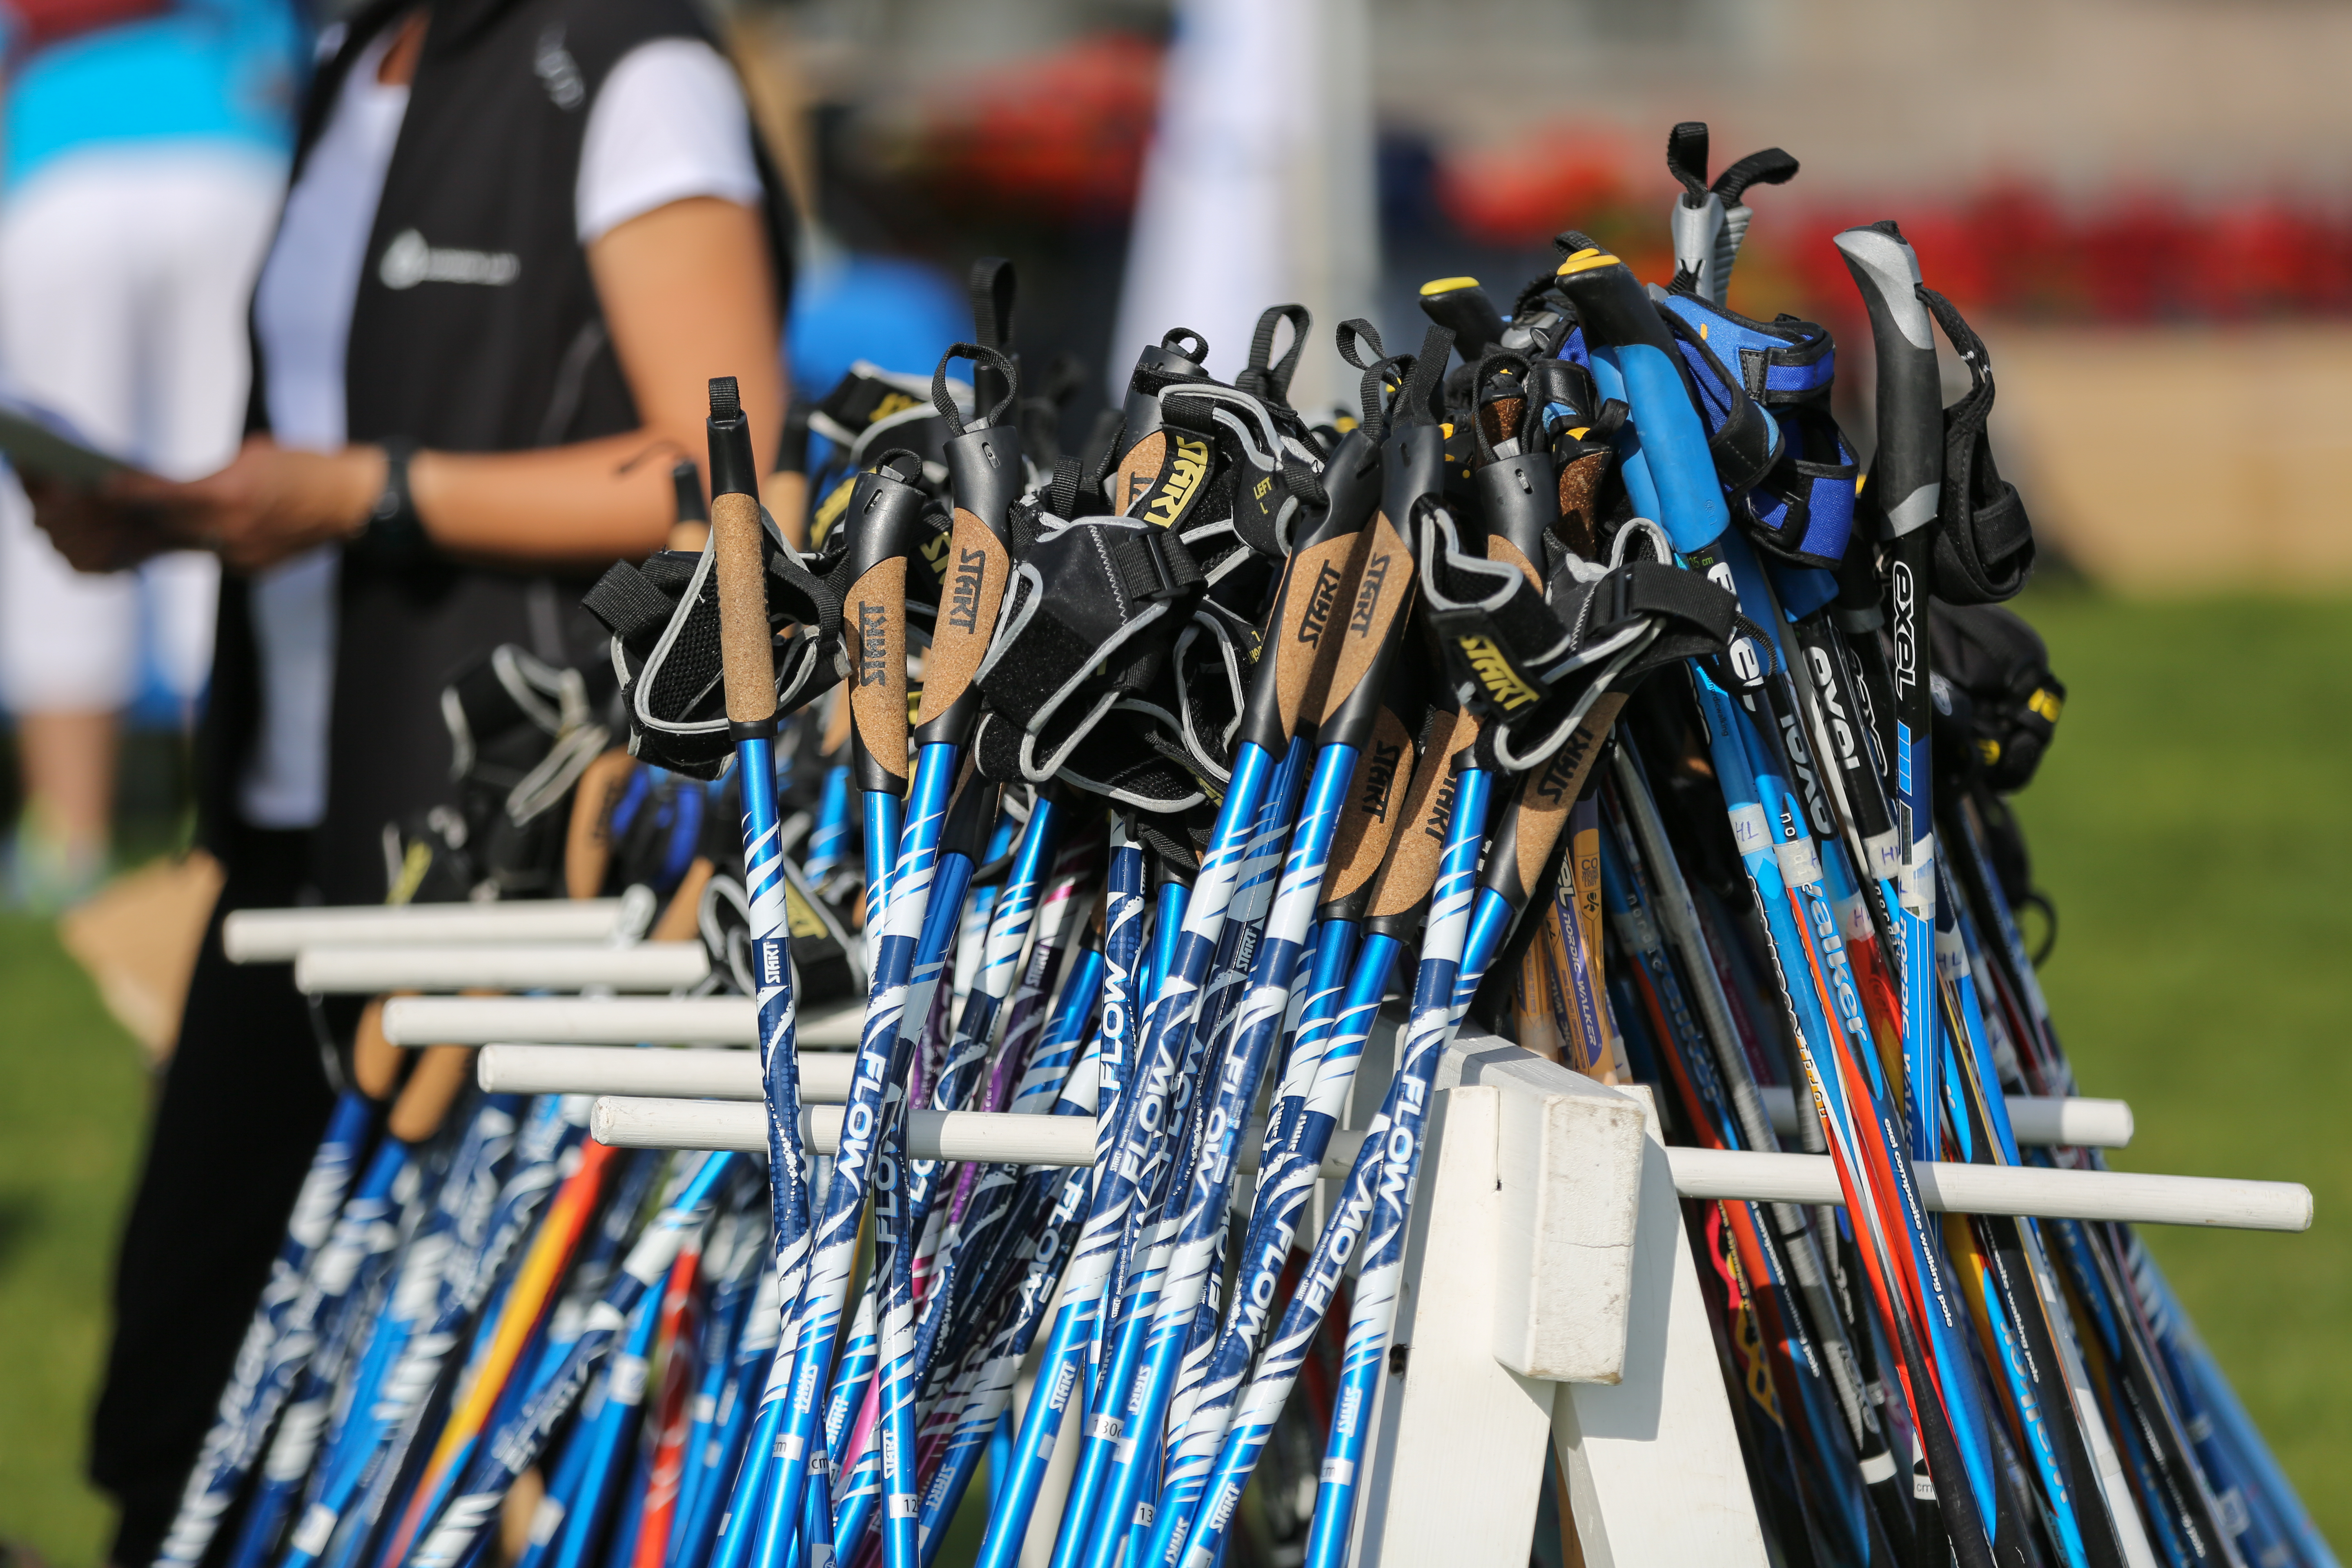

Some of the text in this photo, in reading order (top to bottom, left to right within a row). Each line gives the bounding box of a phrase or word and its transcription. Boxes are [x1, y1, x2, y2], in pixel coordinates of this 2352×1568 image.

[1143, 436, 1208, 529] START
[1254, 477, 1273, 500] LEFT
[949, 548, 986, 635] START
[1298, 559, 1341, 649] START
[1350, 553, 1391, 638] START
[859, 601, 885, 687] START
[1247, 646, 1262, 664] IGHT
[1459, 635, 1540, 711] START
[1362, 740, 1400, 824] START
[1537, 725, 1594, 805] START
[1425, 777, 1457, 849] TART
[1581, 858, 1598, 871] CO
[763, 942, 780, 985] START
[1236, 928, 1258, 972] START
[1099, 951, 1128, 1091] FLOW
[1572, 980, 1597, 1047] WALKER
[838, 1051, 886, 1196] FLOW
[1108, 1149, 1124, 1173] START
[1118, 1132, 1128, 1149] Designed
[1129, 1101, 1138, 1114] Finland
[1120, 1038, 1176, 1185] FLOW
[1196, 1055, 1245, 1199] FLOW
[1379, 1074, 1427, 1221] FLOW
[1305, 1171, 1373, 1317] FLOW
[1884, 1117, 1954, 1328] exel composite walking pole
[1108, 1296, 1122, 1319] START
[1115, 1279, 1124, 1295] Designed
[1236, 1219, 1296, 1357] FLOW
[1295, 1278, 1310, 1301] START
[1754, 1209, 1786, 1286] composite
[1802, 1345, 1820, 1378] pole
[2007, 1291, 2029, 1349] walking
[2025, 1350, 2039, 1383] pole
[794, 1362, 818, 1414] START
[826, 1394, 850, 1446] START
[1049, 1361, 1077, 1413] START
[1127, 1364, 1151, 1416] START
[1337, 1386, 1363, 1438] START
[882, 1428, 898, 1480] START
[926, 1463, 957, 1512] START
[1916, 1484, 1933, 1494] cm
[1209, 1482, 1241, 1535] START
